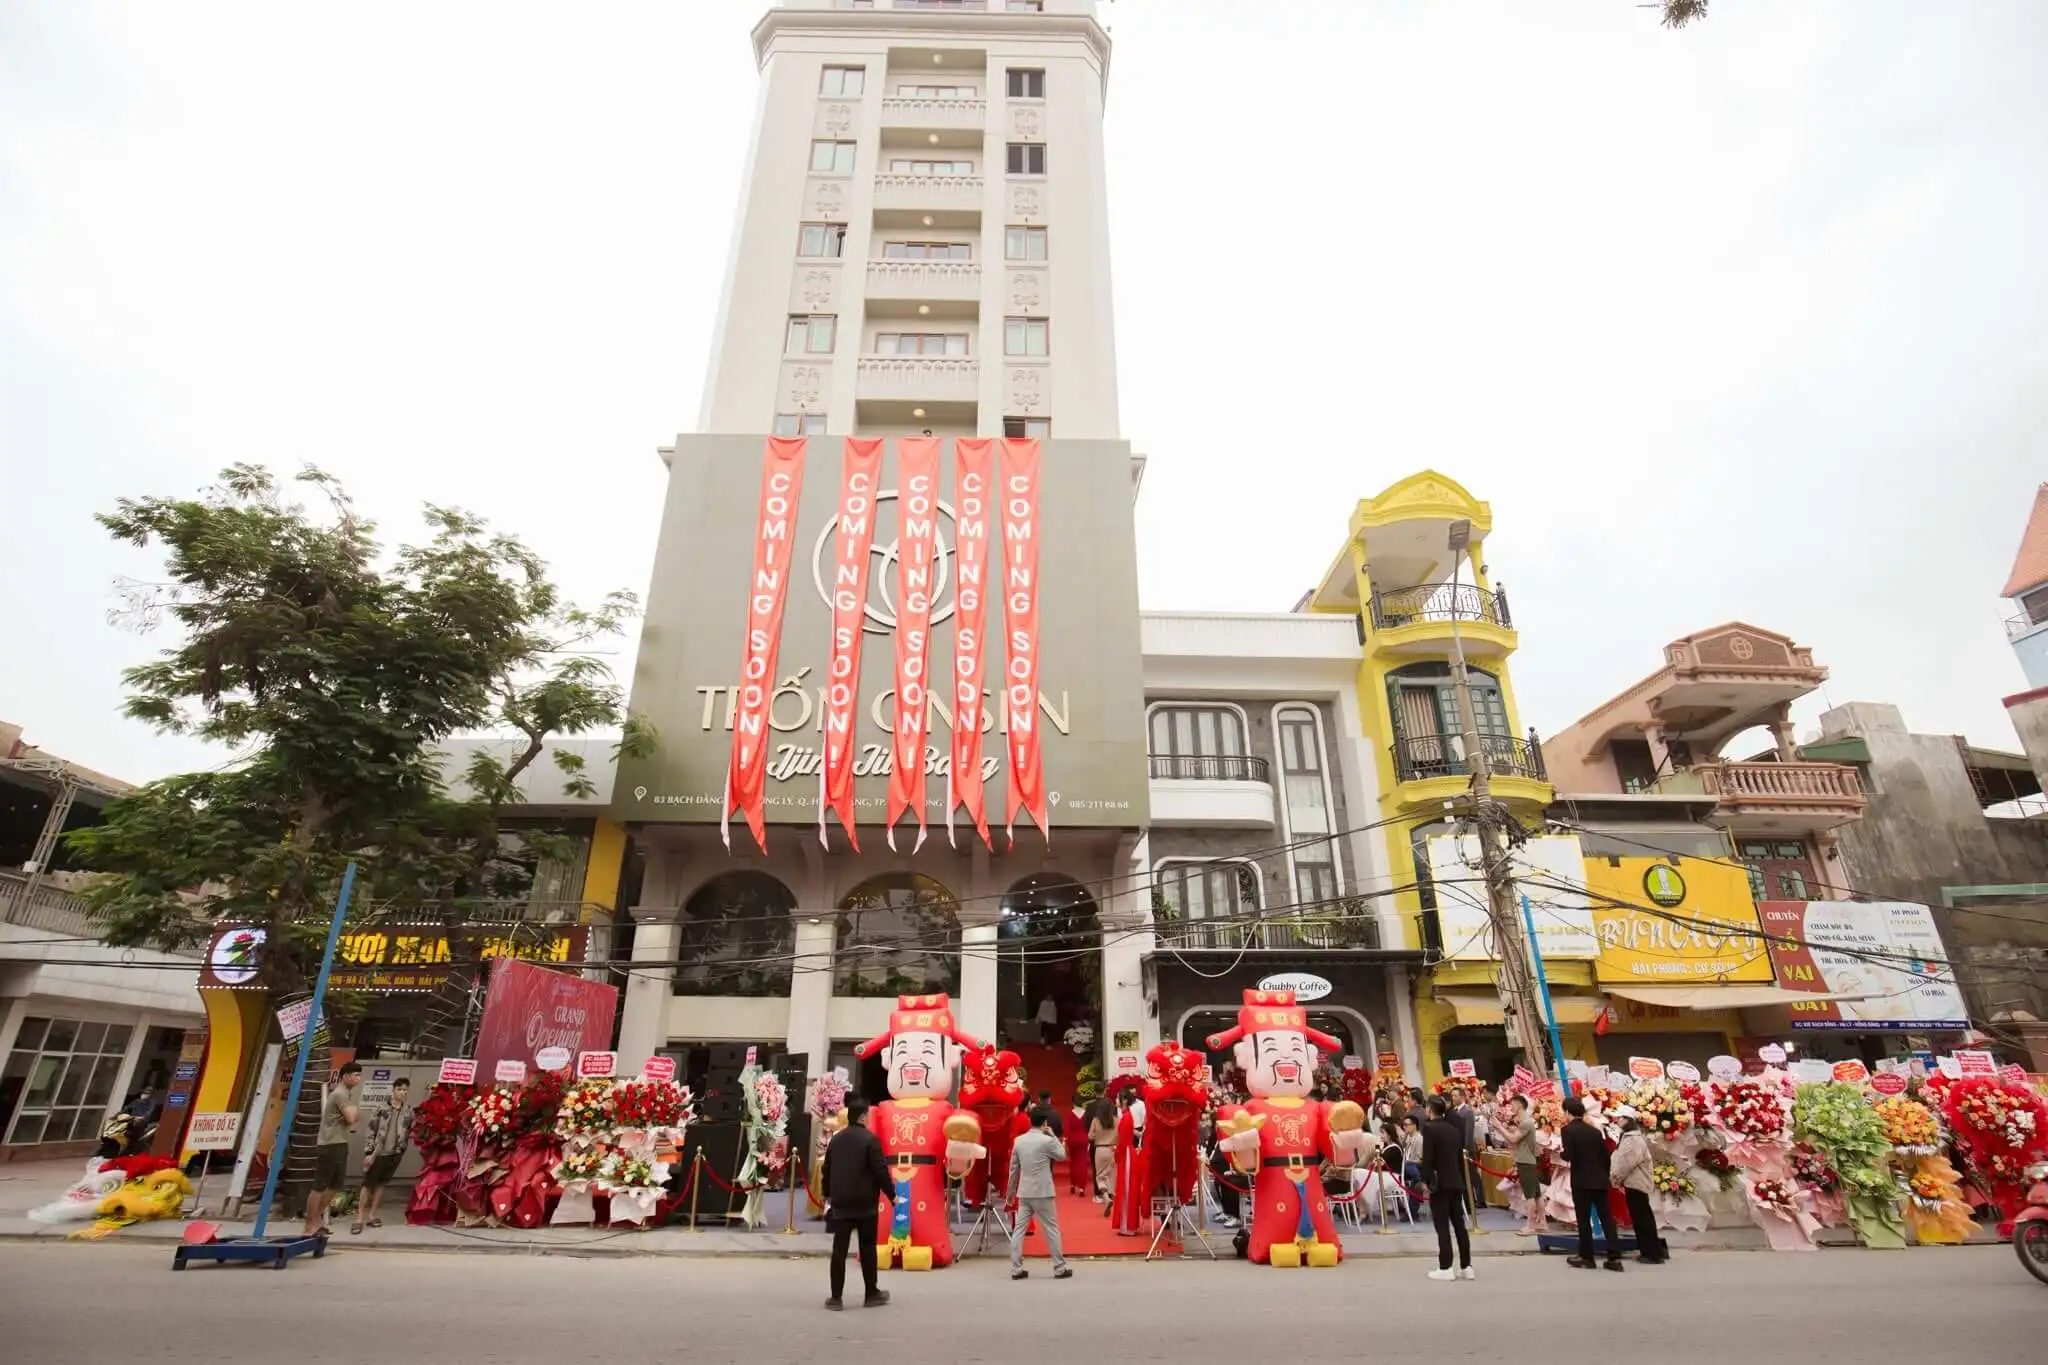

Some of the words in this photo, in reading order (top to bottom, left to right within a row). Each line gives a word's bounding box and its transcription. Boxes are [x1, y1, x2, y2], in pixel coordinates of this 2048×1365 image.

[753, 473, 790, 614] COMING
[835, 473, 870, 611] COMING
[904, 475, 930, 614] COMING
[959, 473, 983, 611] COMING
[1007, 476, 1032, 614] COMING
[554, 1006, 585, 1025] GRAND
[1263, 981, 1297, 992] Chubby
[1299, 980, 1328, 992] Coffee
